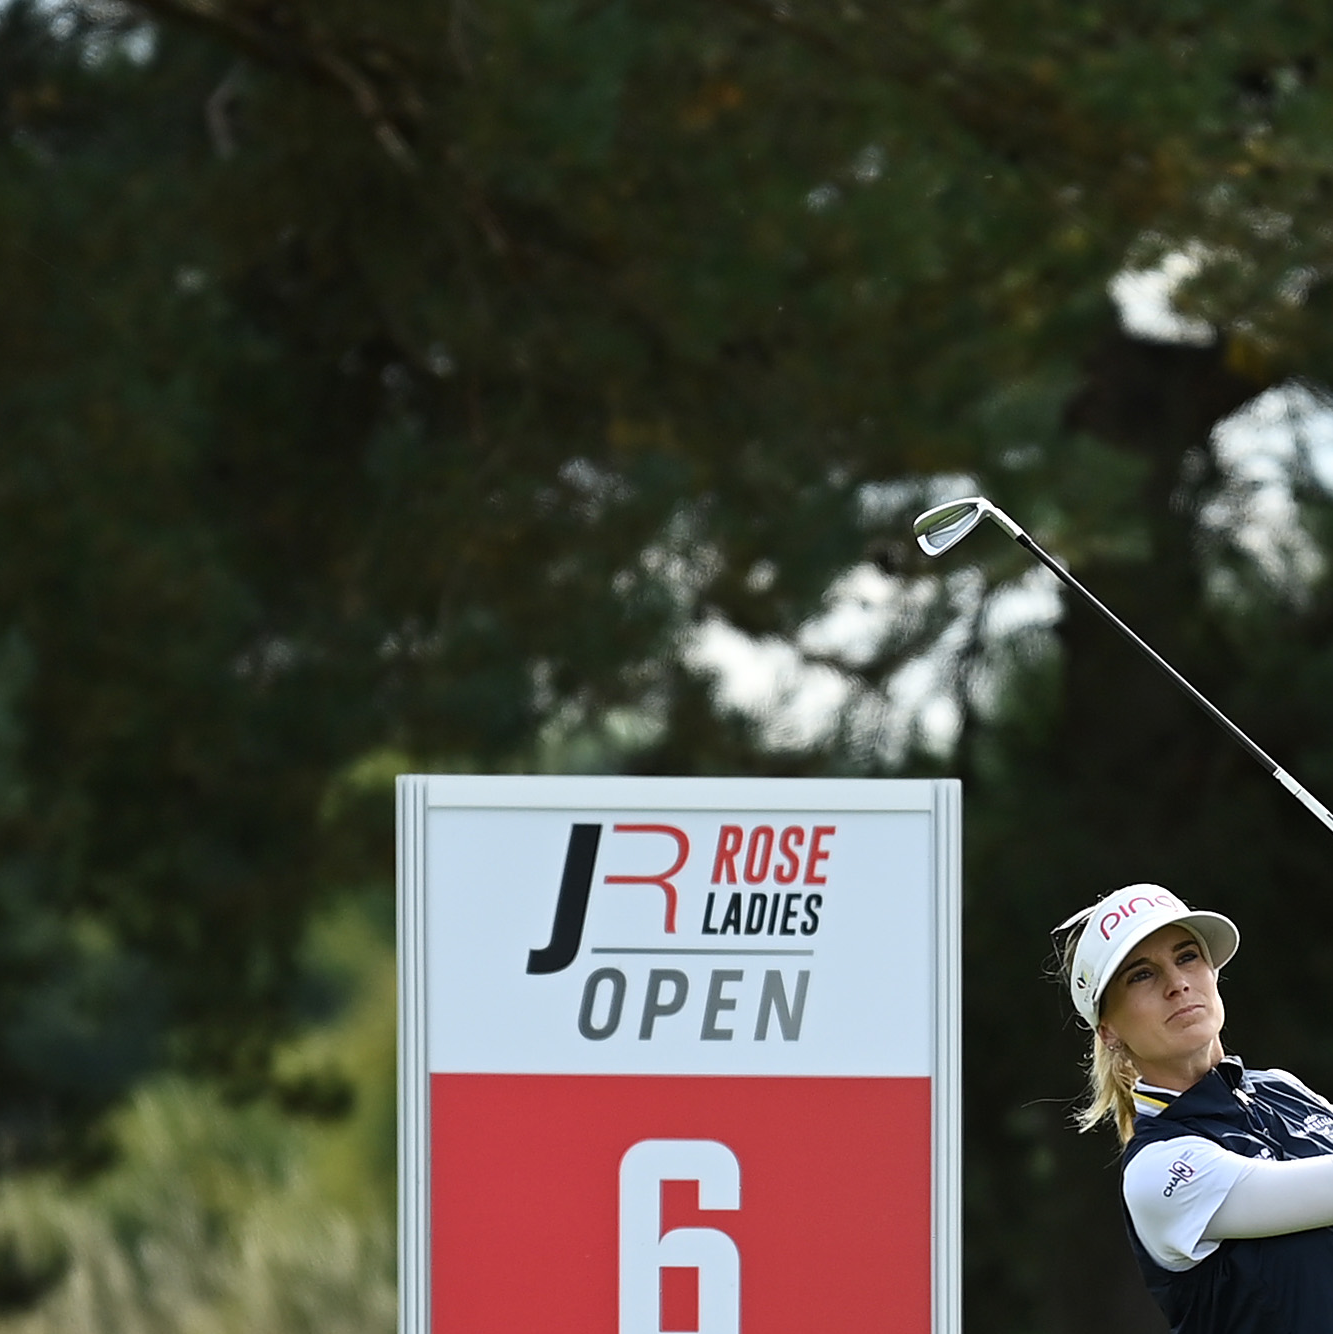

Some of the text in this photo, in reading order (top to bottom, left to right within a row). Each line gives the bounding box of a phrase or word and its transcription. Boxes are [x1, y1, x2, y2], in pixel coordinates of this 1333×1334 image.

[711, 824, 836, 886] ROSE
[701, 892, 823, 936] LADIES
[578, 966, 811, 1042] OPEN
